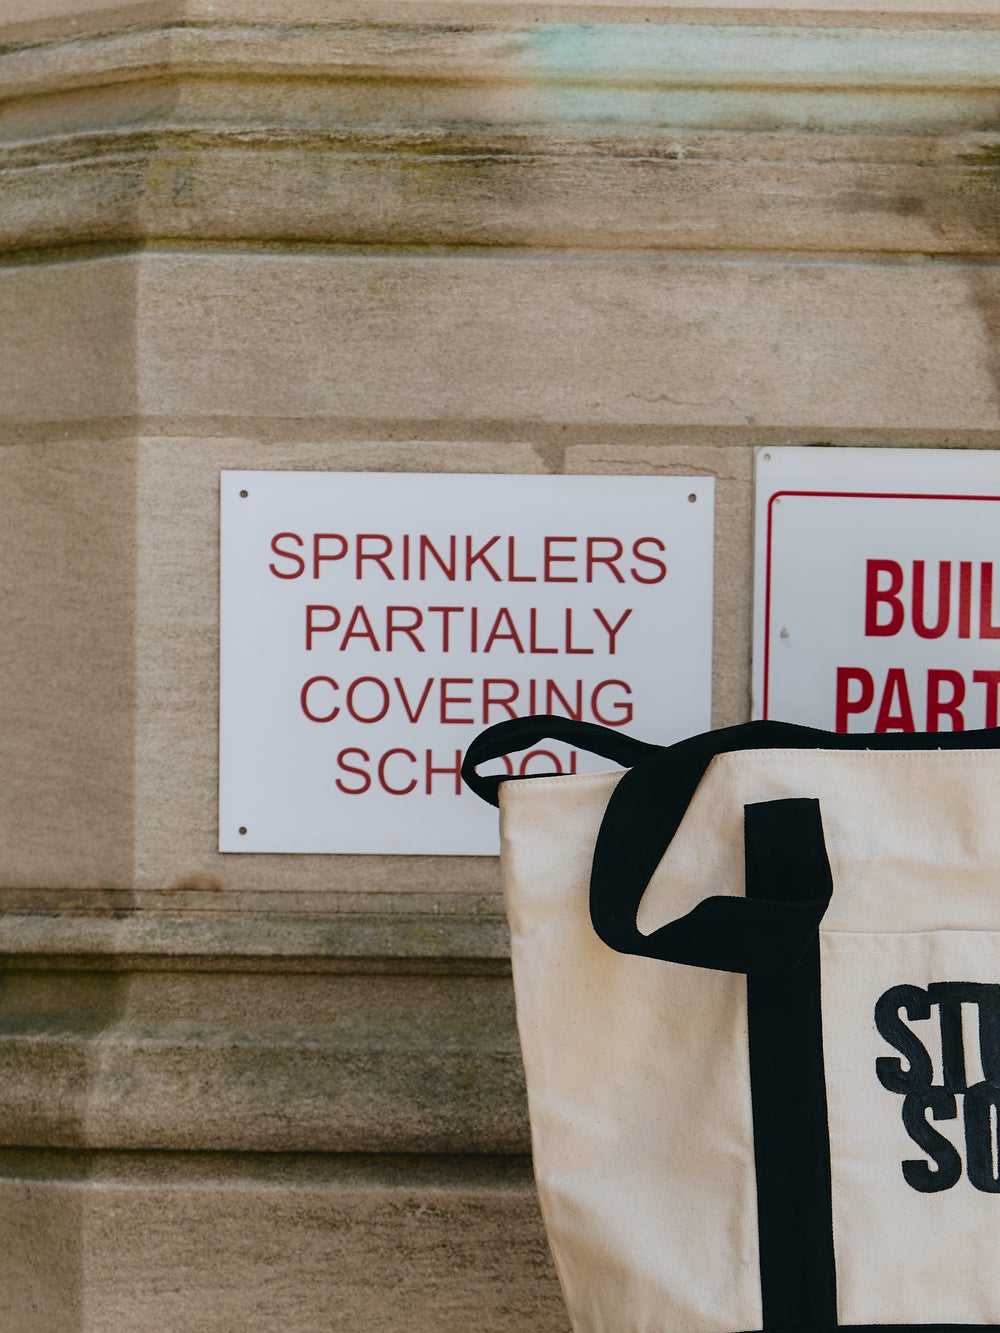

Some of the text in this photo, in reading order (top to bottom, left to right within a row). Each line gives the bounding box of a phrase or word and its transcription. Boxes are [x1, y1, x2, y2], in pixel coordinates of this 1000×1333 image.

[269, 532, 667, 585] SPRINKLERS
[305, 604, 633, 655] PARTIALLY
[300, 675, 634, 727] COVERING
